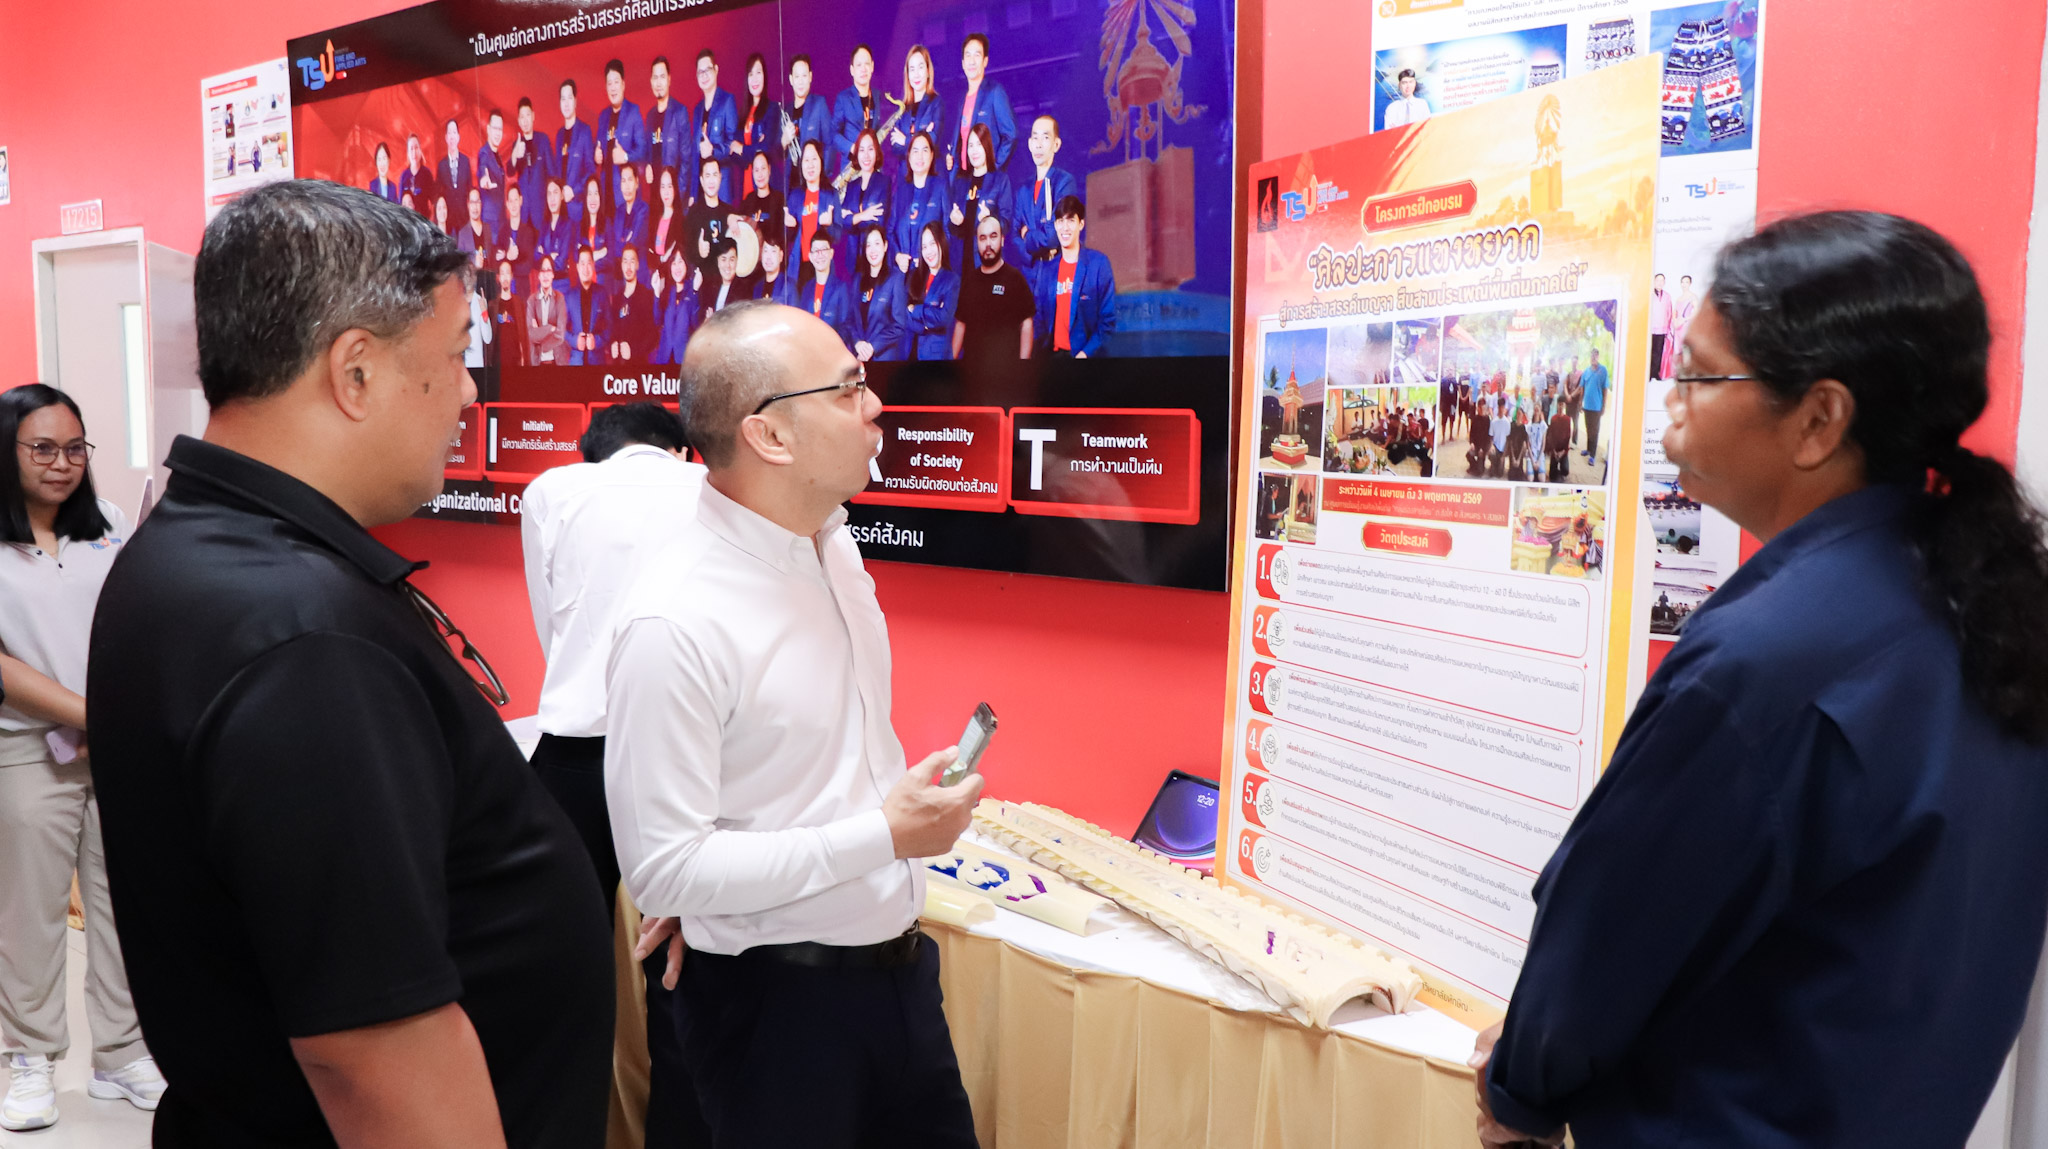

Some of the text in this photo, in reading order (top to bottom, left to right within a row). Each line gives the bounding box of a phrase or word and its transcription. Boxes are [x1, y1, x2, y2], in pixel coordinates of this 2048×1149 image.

[297, 39, 335, 90] TSU
[1281, 174, 1318, 222] TSU
[1684, 177, 1717, 198] TSU
[66, 206, 97, 230] 17215
[1375, 193, 1463, 223] โครงการฝึกอบรม
[603, 373, 638, 395] Core
[522, 420, 554, 432] Initiative
[898, 427, 974, 445] Responsibility
[1081, 433, 1149, 450] Teamwork
[910, 454, 963, 471] of Society
[1019, 429, 1056, 491] T
[1070, 456, 1163, 475] การทำงานเป็นทีม
[885, 476, 998, 494] ความรับผิดชอบต่อสังคม
[422, 490, 507, 513] ganizational
